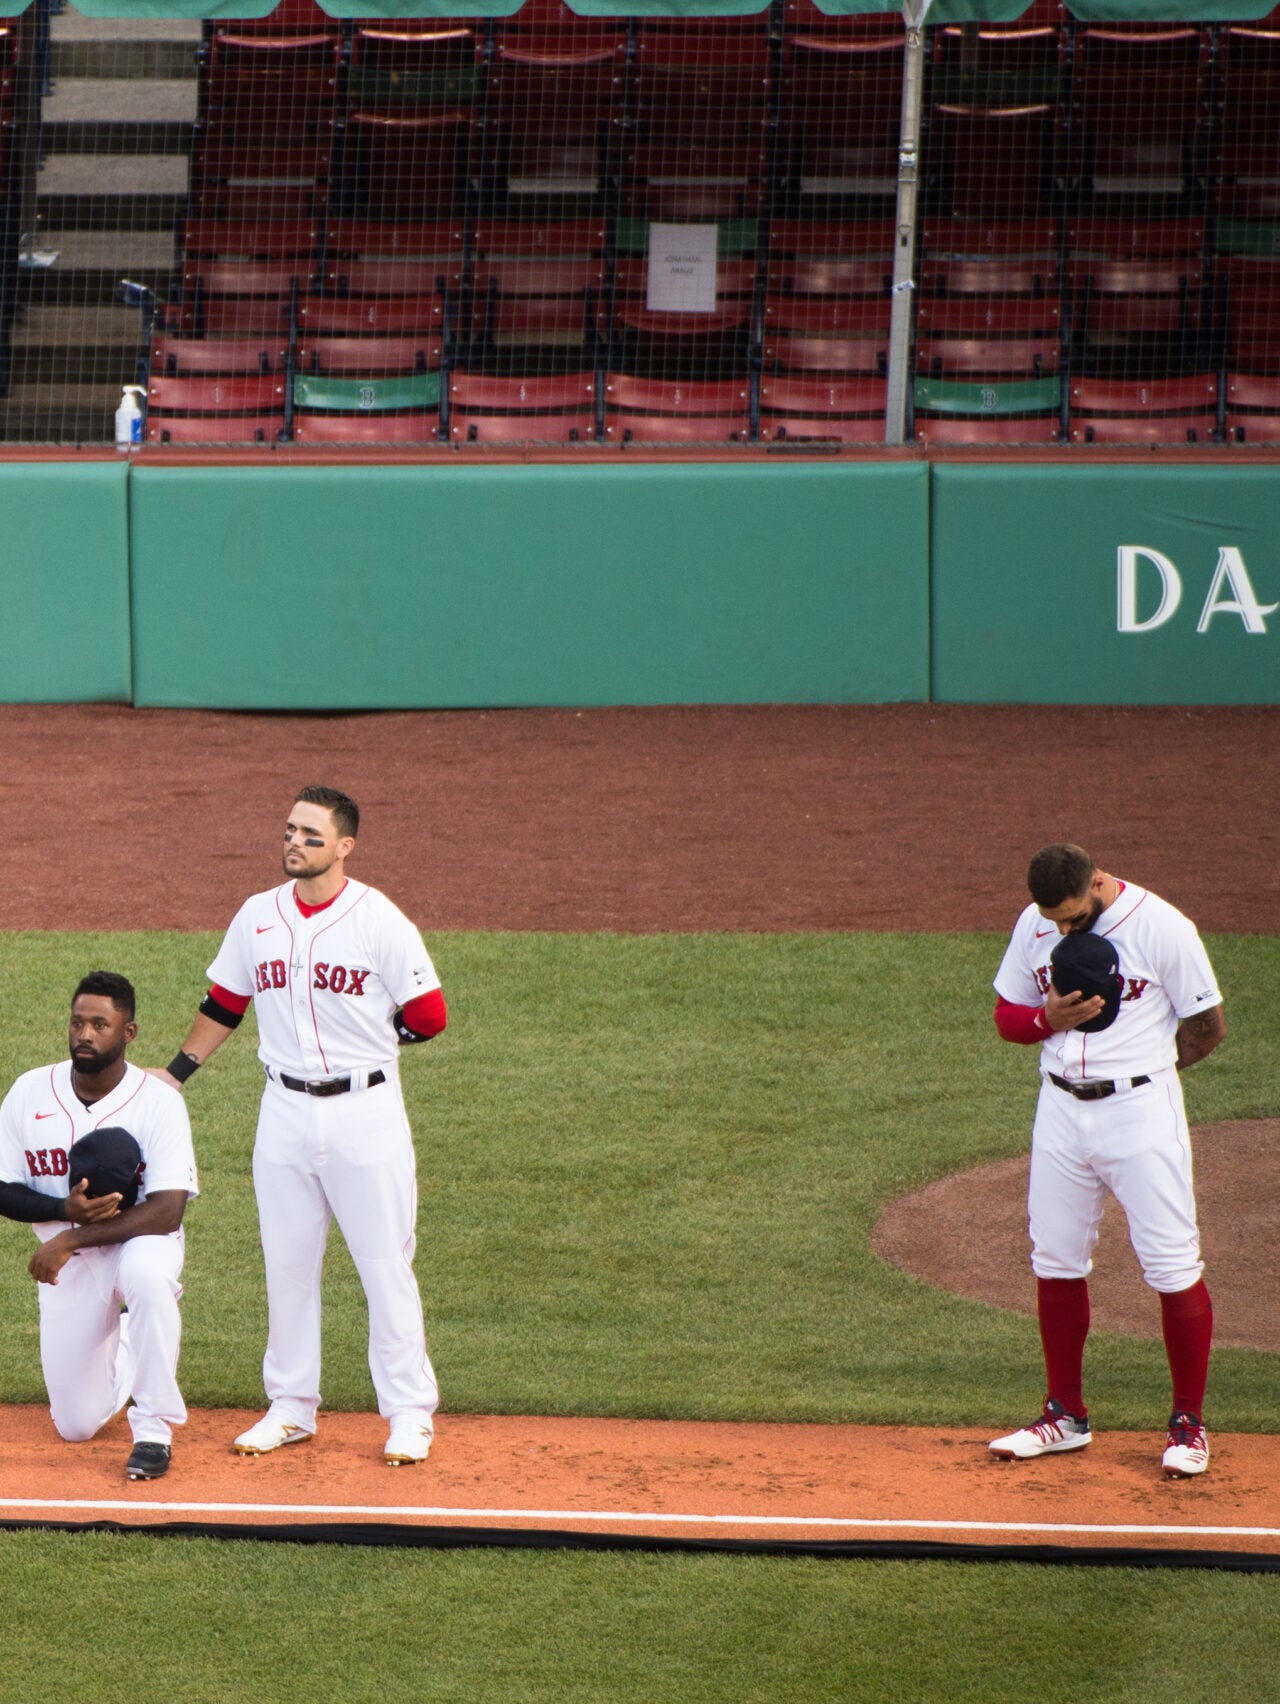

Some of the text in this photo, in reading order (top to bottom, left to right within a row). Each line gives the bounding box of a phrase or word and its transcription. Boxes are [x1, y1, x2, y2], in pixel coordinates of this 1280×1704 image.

[359, 386, 375, 408] B
[980, 388, 997, 409] B
[1117, 545, 1280, 633] DA
[313, 961, 371, 996] SOX
[24, 1147, 69, 1177] RED
